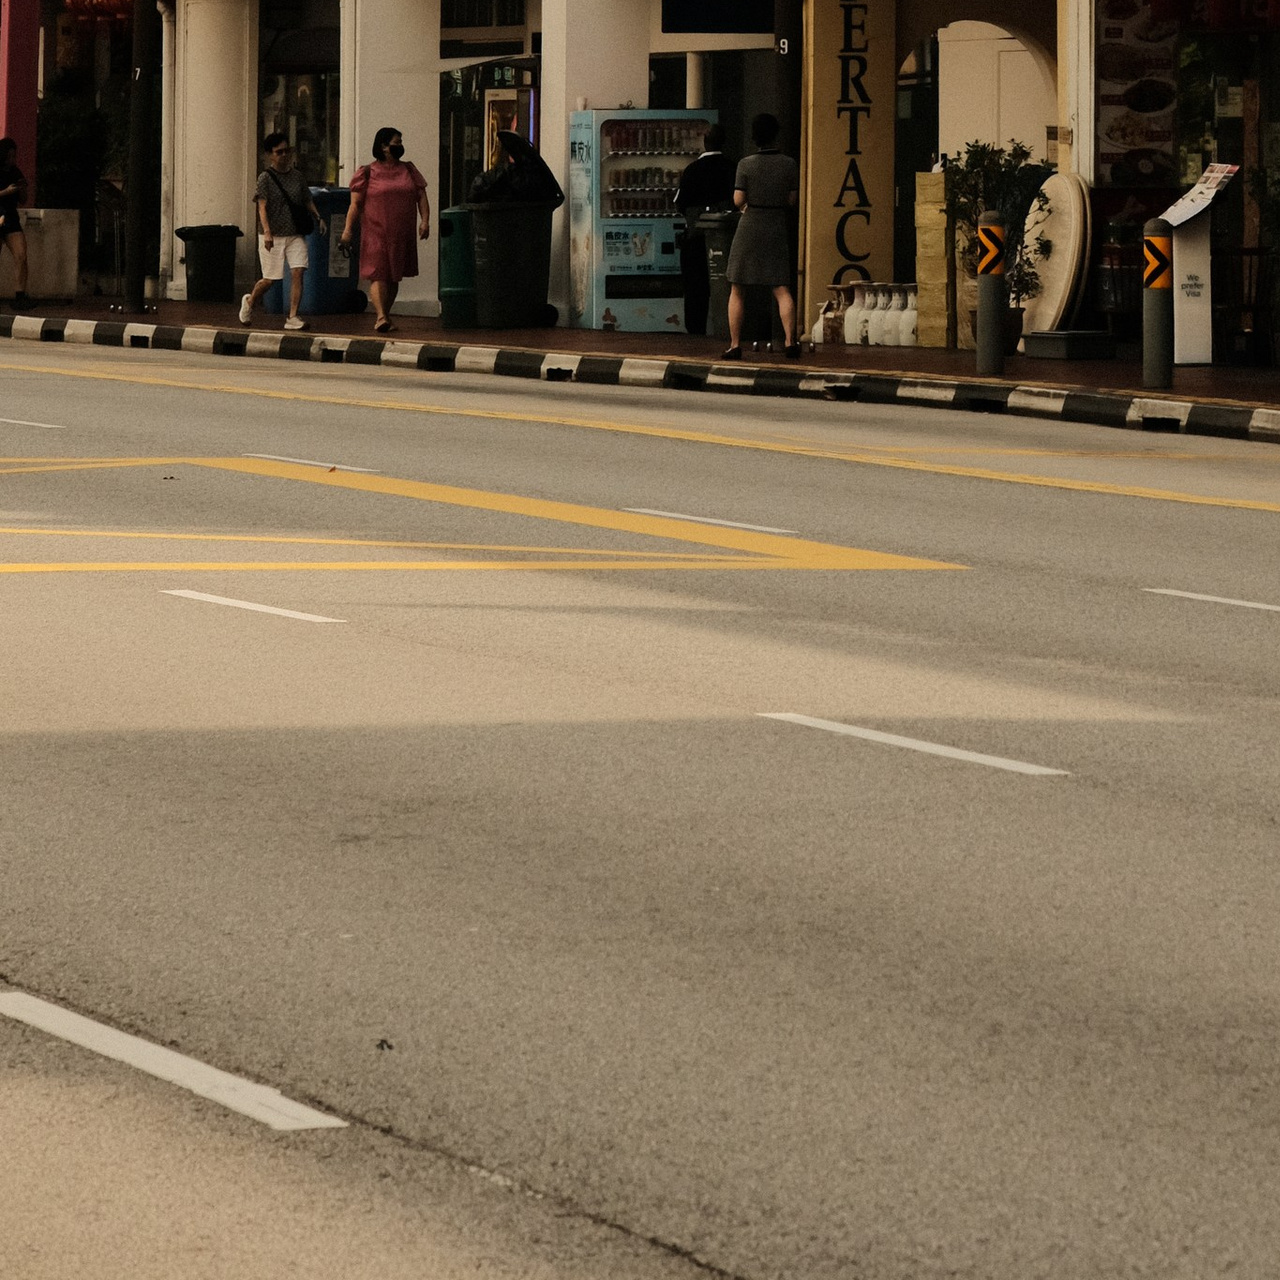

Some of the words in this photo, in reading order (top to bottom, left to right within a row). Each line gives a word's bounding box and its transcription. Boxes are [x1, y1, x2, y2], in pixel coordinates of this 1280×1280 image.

[779, 39, 789, 55] 9
[1186, 274, 1200, 282] We
[1181, 282, 1205, 291] prefer
